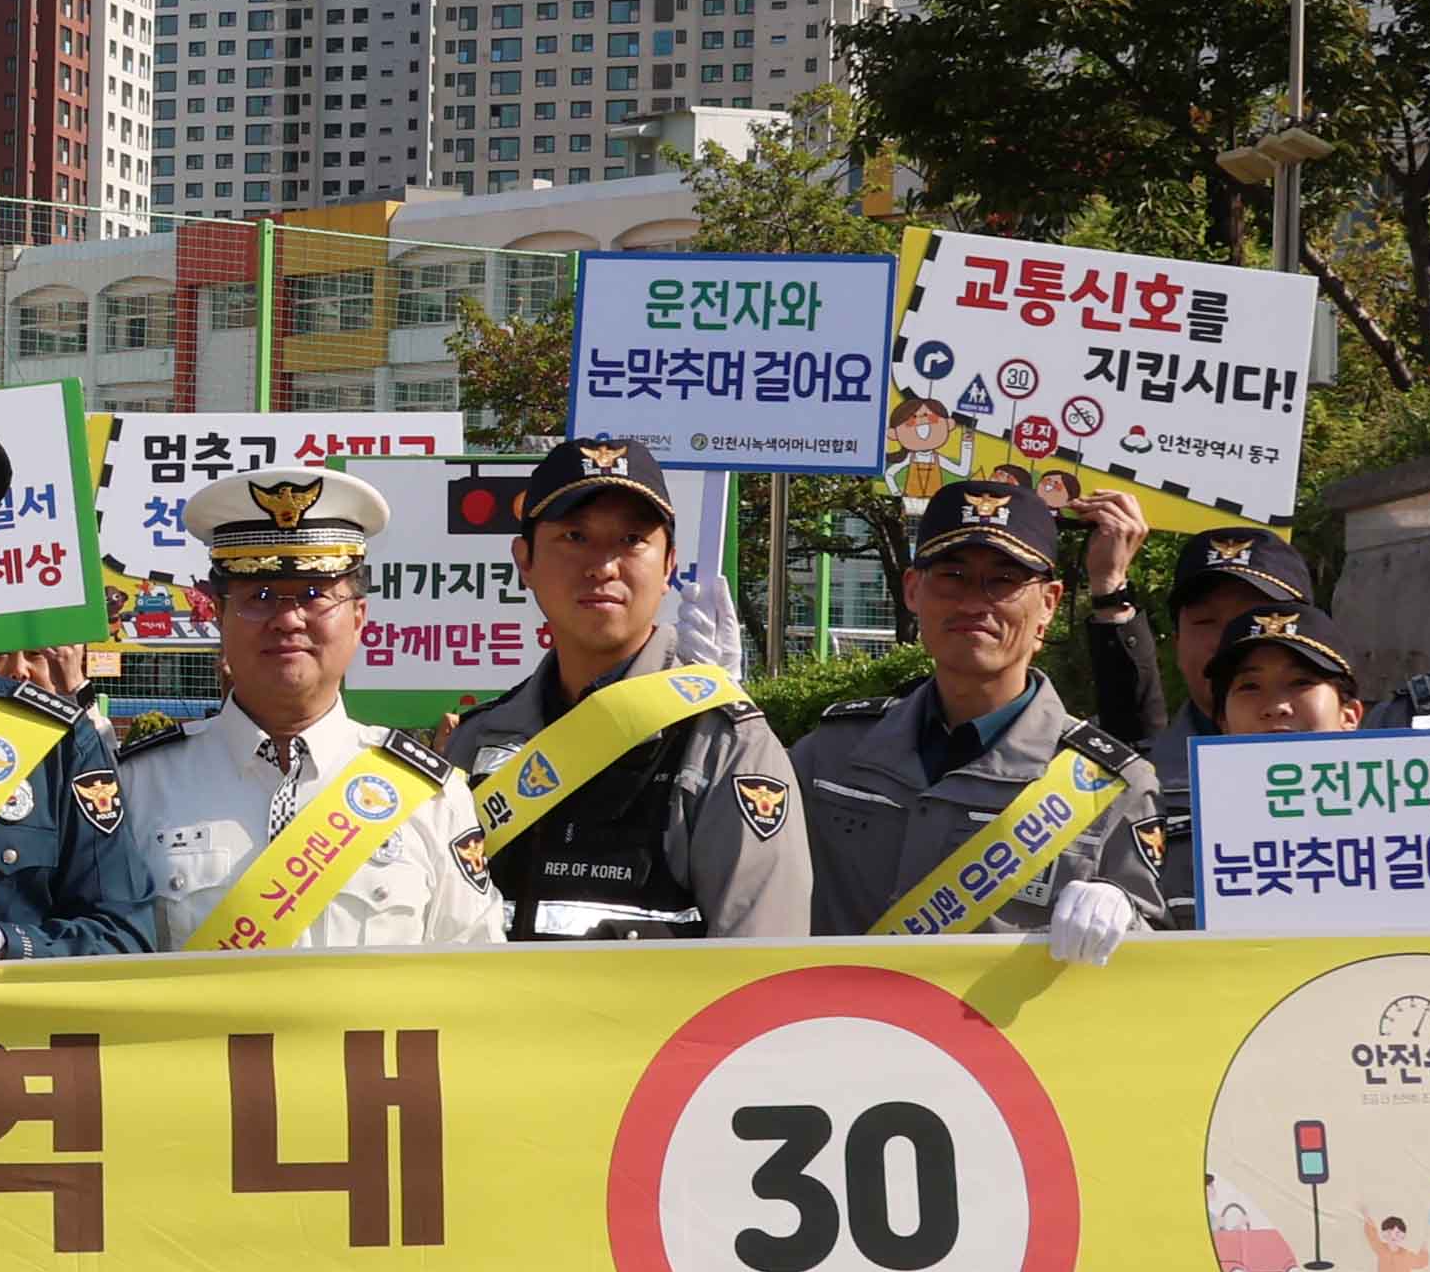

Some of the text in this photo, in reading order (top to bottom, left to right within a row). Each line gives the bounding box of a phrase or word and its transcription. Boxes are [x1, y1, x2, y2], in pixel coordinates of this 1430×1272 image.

[645, 279, 822, 331] 운전자와
[955, 255, 1229, 344] 교통신호를
[587, 348, 872, 403] 눈맞추며 걸어요
[1007, 368, 1029, 387] 30
[1083, 346, 1298, 414] 지킵시다!
[144, 432, 277, 484] 멈추고
[711, 435, 857, 453] 인천시녹색어머니연합회
[1021, 439, 1050, 451] STOP
[1158, 434, 1280, 464] 인천광역시 동구
[367, 562, 527, 604] 내가지킨
[360, 620, 524, 666] 함께만든
[1013, 794, 1072, 854] 우리
[260, 810, 361, 921] 어린이가
[544, 861, 633, 881] REP. OF KOREA
[958, 841, 1021, 902] 아이
[1213, 836, 1376, 897] 눈맞추며
[228, 1029, 445, 1248] 내
